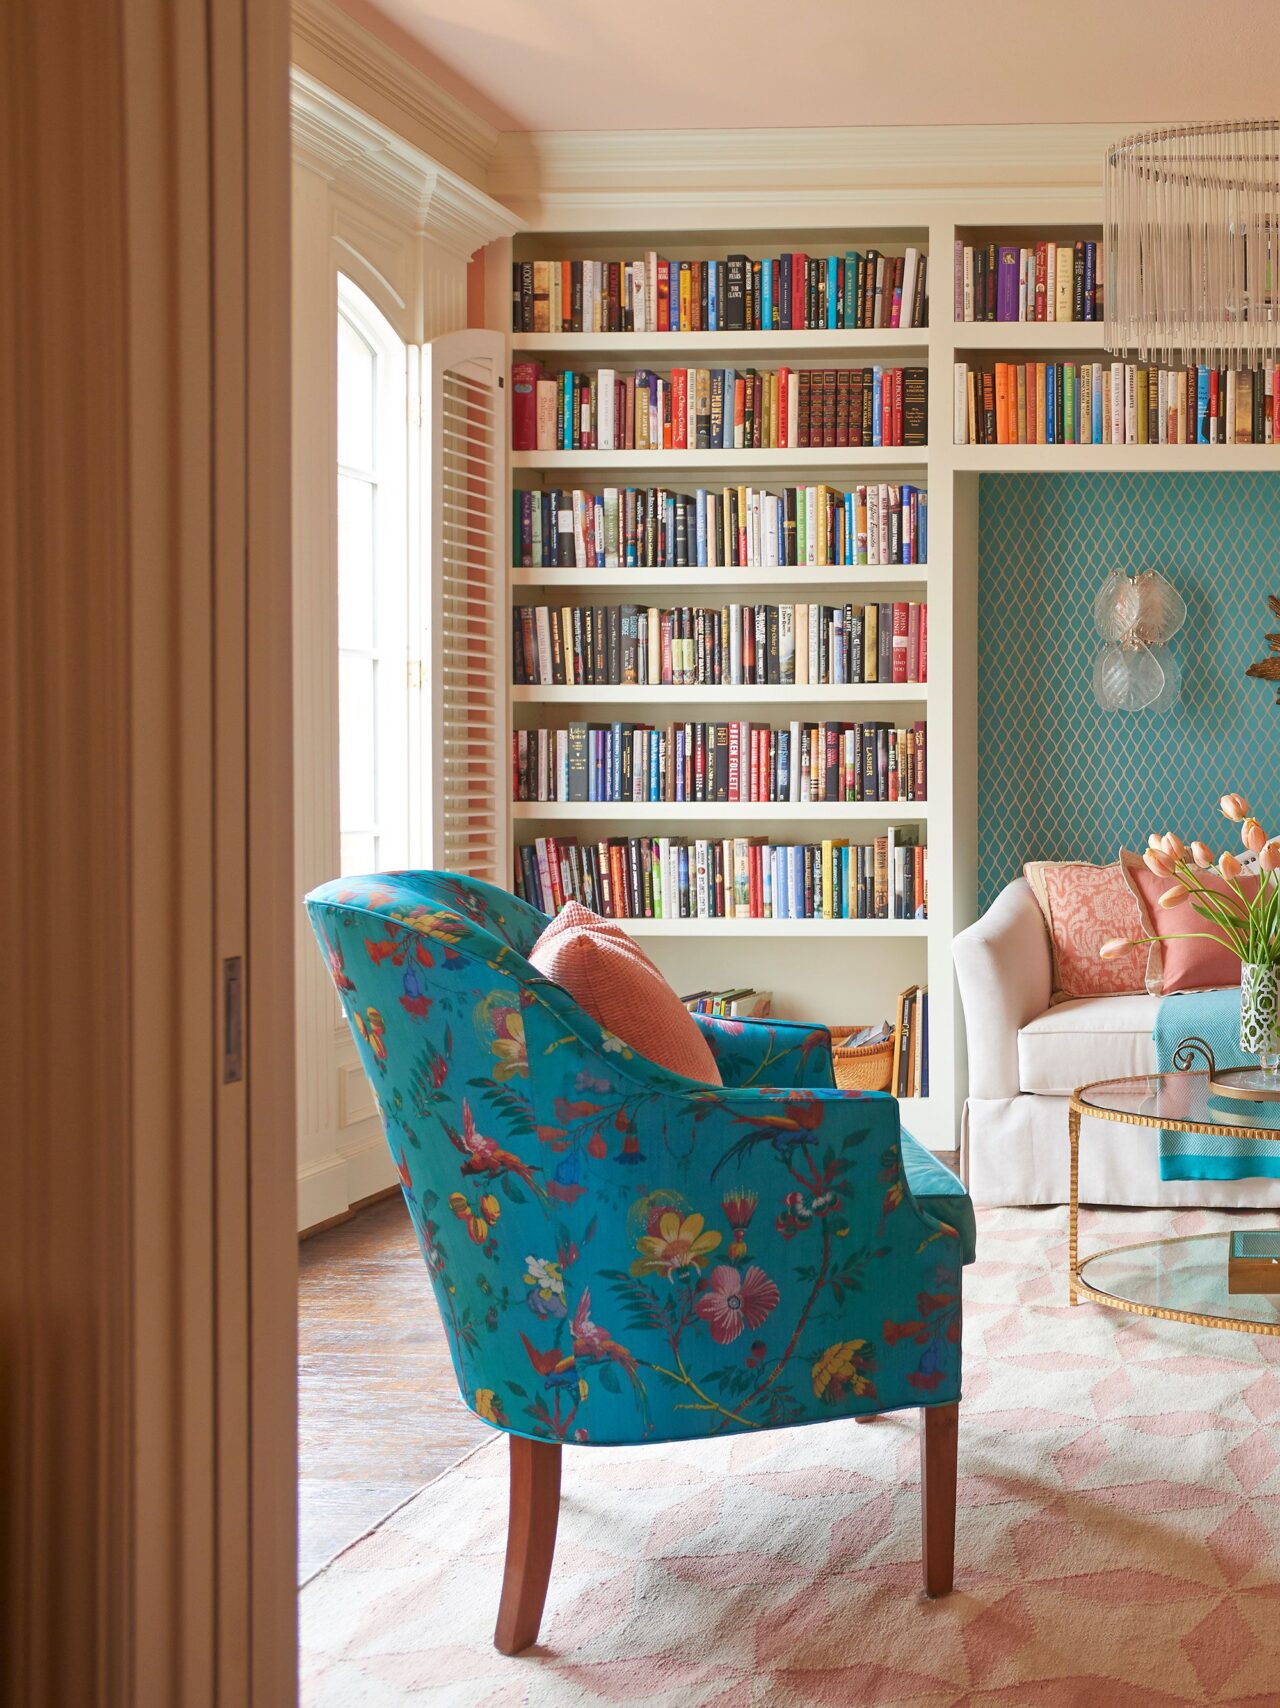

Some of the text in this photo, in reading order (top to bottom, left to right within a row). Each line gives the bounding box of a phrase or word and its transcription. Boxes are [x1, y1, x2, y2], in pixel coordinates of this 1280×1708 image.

[1150, 367, 1158, 384] STEVE
[711, 395, 721, 424] MONEY
[676, 418, 686, 441] Cooking
[878, 840, 886, 868] DAN BROWN
